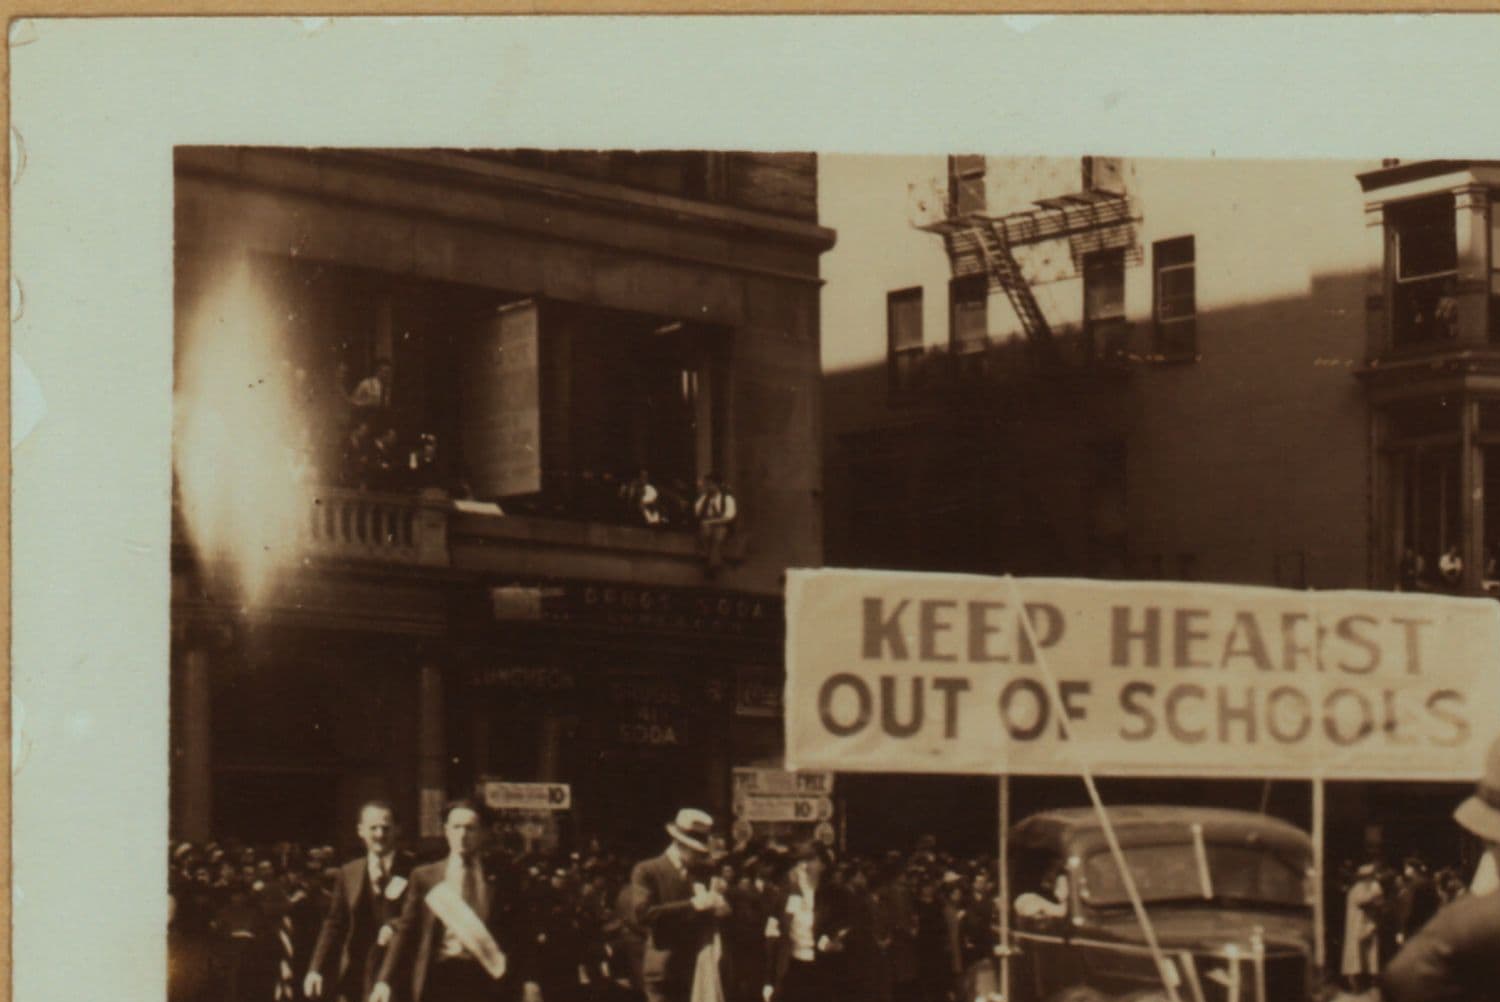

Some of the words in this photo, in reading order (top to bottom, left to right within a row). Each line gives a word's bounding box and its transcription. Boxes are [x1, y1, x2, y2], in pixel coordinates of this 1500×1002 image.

[697, 597, 764, 618] SODA
[862, 598, 1065, 664] KEEP
[1110, 605, 1433, 676] HEARST
[818, 673, 971, 740] OUT
[1000, 678, 1091, 742] OF
[1118, 681, 1471, 747] SCHOOLS
[619, 724, 678, 744] SODA
